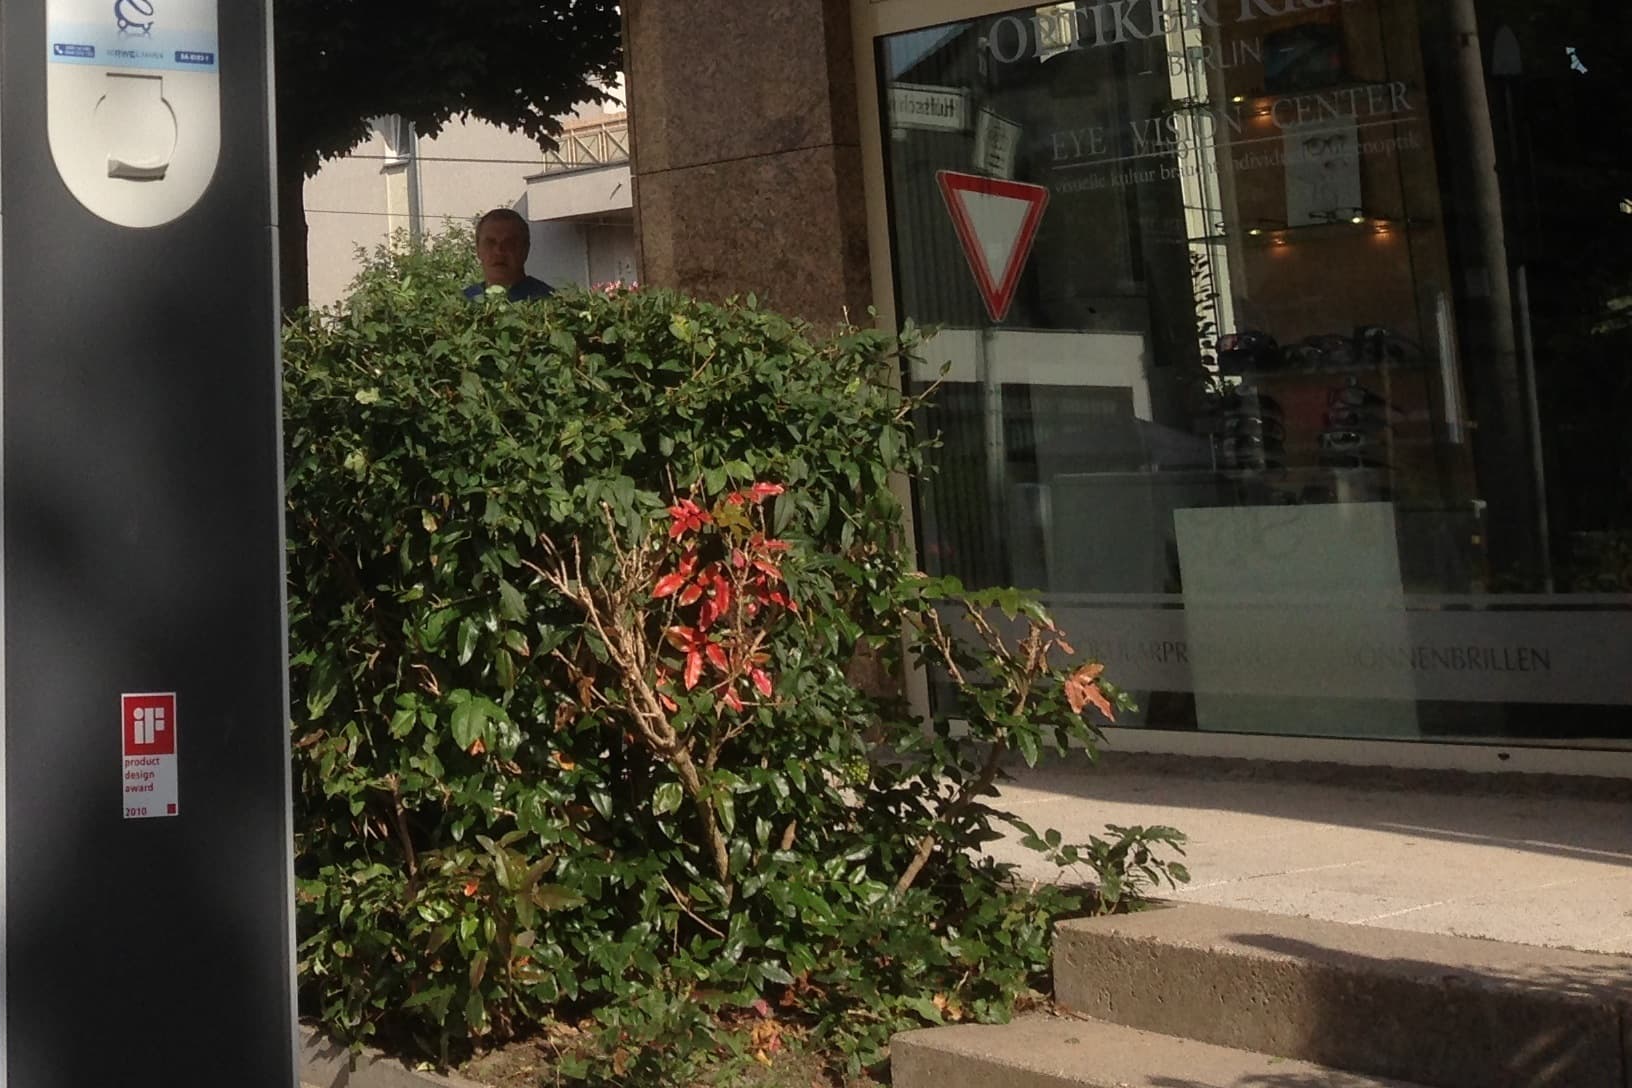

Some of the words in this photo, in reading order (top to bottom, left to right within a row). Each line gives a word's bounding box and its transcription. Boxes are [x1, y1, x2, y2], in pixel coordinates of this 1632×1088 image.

[1169, 36, 1263, 77] BERLIN
[1050, 126, 1107, 161] EYE
[1129, 105, 1244, 147] VISION
[1270, 79, 1415, 130] CENTER
[1111, 168, 1157, 191] kultur
[124, 757, 161, 768] product
[124, 770, 156, 781] design
[125, 782, 154, 793] award
[125, 807, 148, 817] 2010
